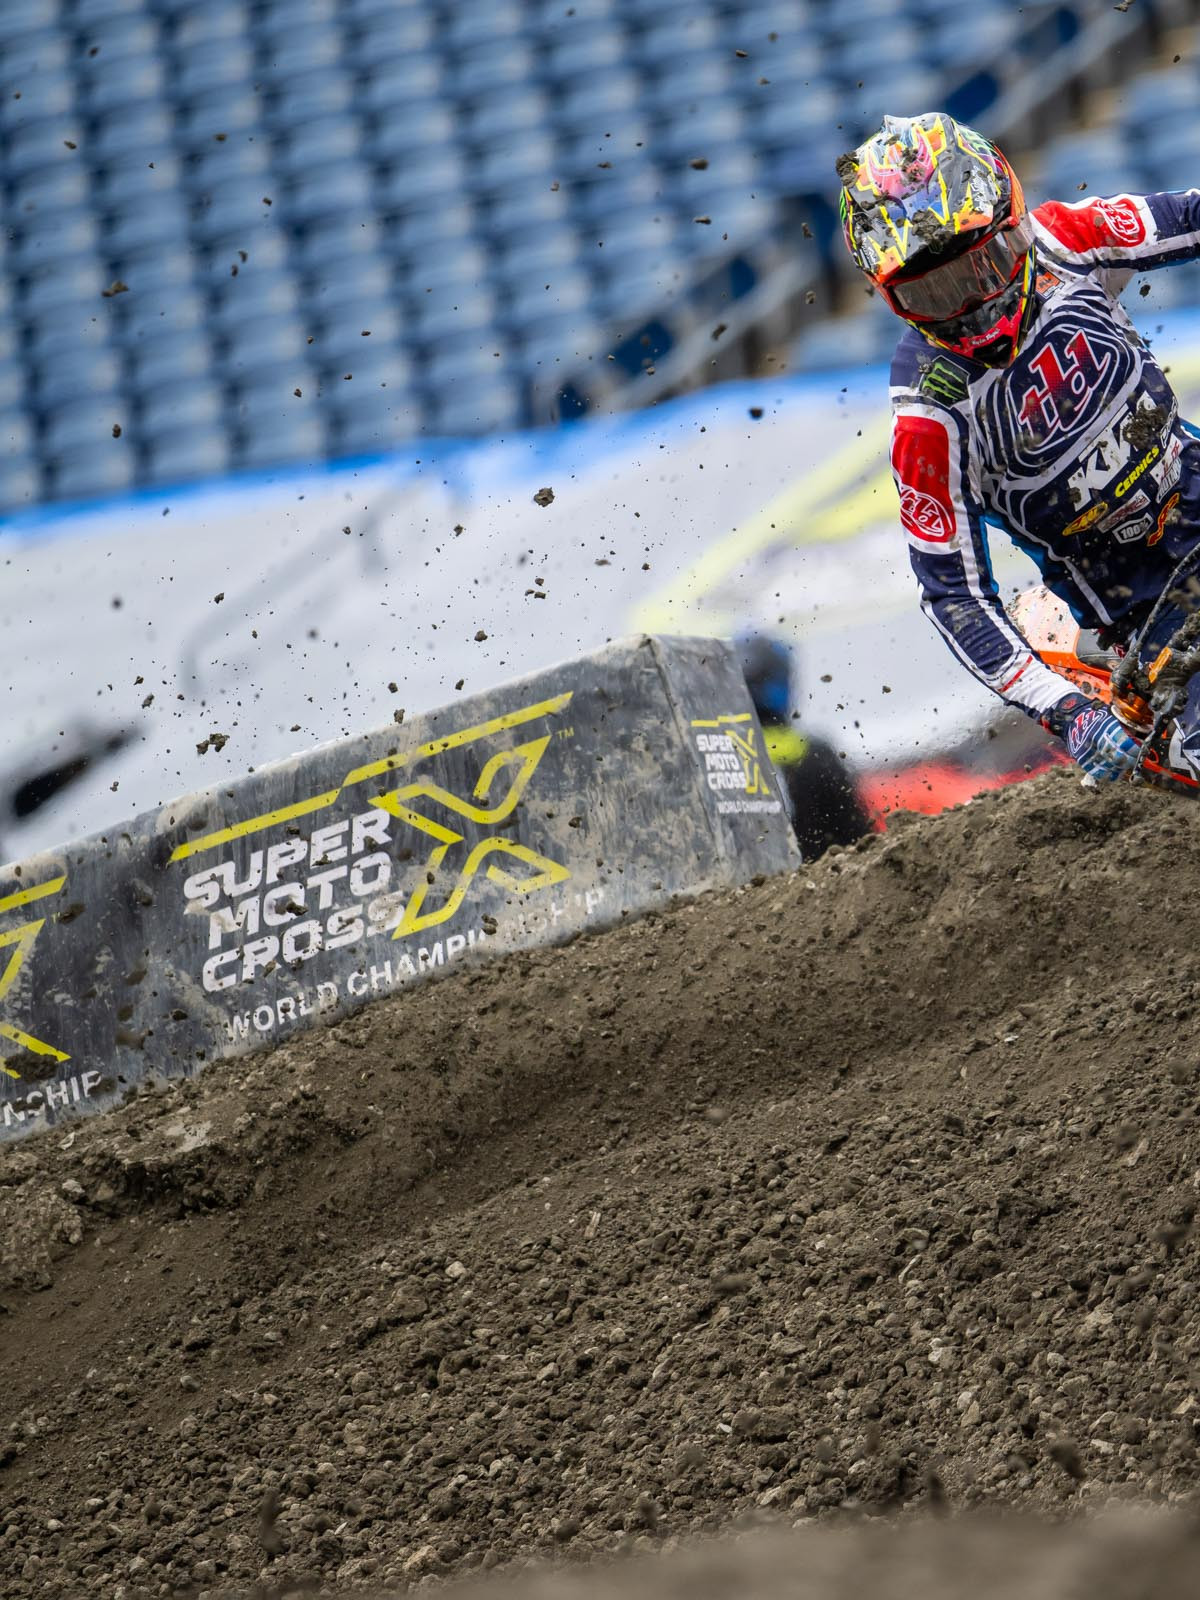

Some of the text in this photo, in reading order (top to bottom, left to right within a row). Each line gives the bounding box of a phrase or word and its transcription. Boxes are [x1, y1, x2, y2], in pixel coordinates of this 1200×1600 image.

[1114, 446, 1160, 498] CERNICS
[696, 734, 736, 752] SUPER
[705, 752, 740, 771] MOTO
[707, 771, 747, 790] CROSS
[183, 808, 392, 915] SUPER
[208, 851, 392, 950] MOTO
[202, 890, 405, 992] CROSS
[226, 980, 339, 1042] WORLD
